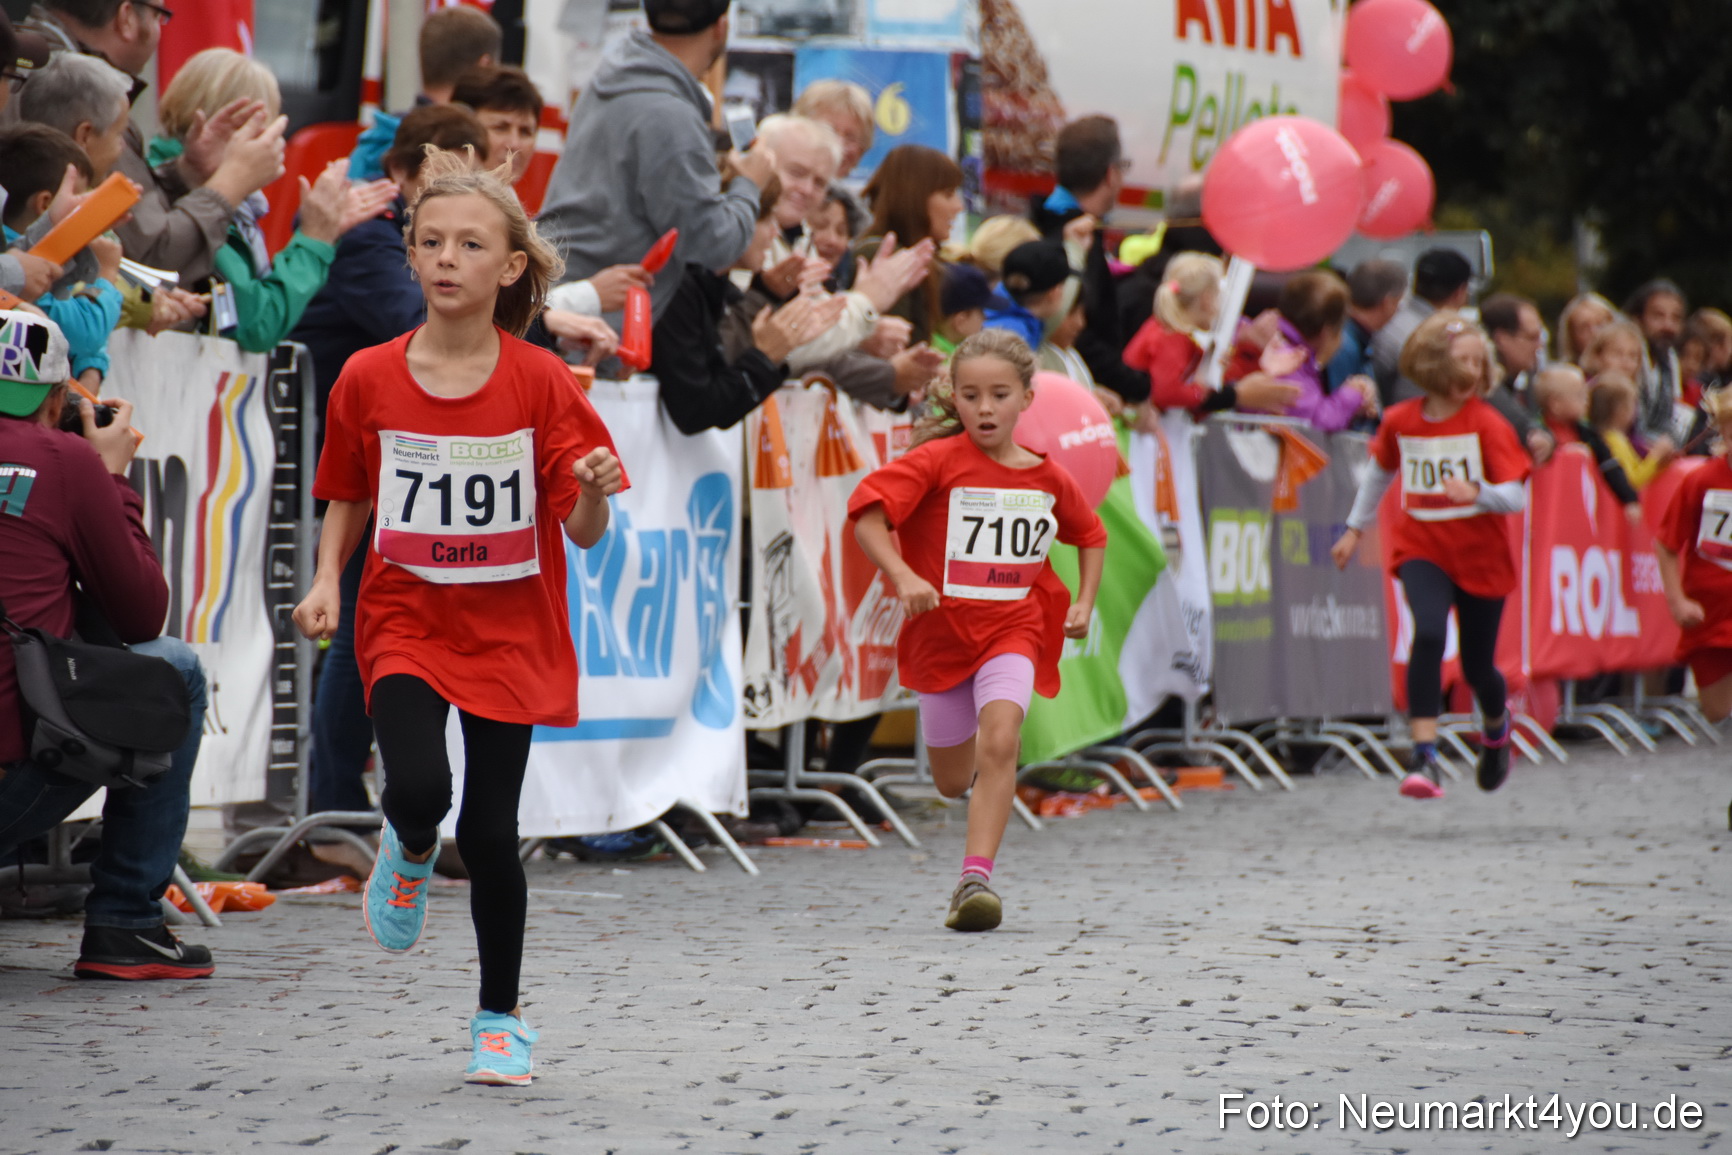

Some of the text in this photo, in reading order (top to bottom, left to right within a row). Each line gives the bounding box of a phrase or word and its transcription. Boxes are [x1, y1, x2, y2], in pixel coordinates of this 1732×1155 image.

[1174, 0, 1303, 57] AVIA
[1157, 64, 1301, 170] Pell
[393, 447, 440, 461] NeuerMarkt
[449, 436, 525, 460] BOCK
[1407, 457, 1470, 489] 7061
[396, 469, 521, 526] 7191
[384, 514, 534, 527] 3 K
[962, 516, 1050, 557] 7102
[432, 541, 488, 562] Carla
[987, 568, 1021, 584] Anna
